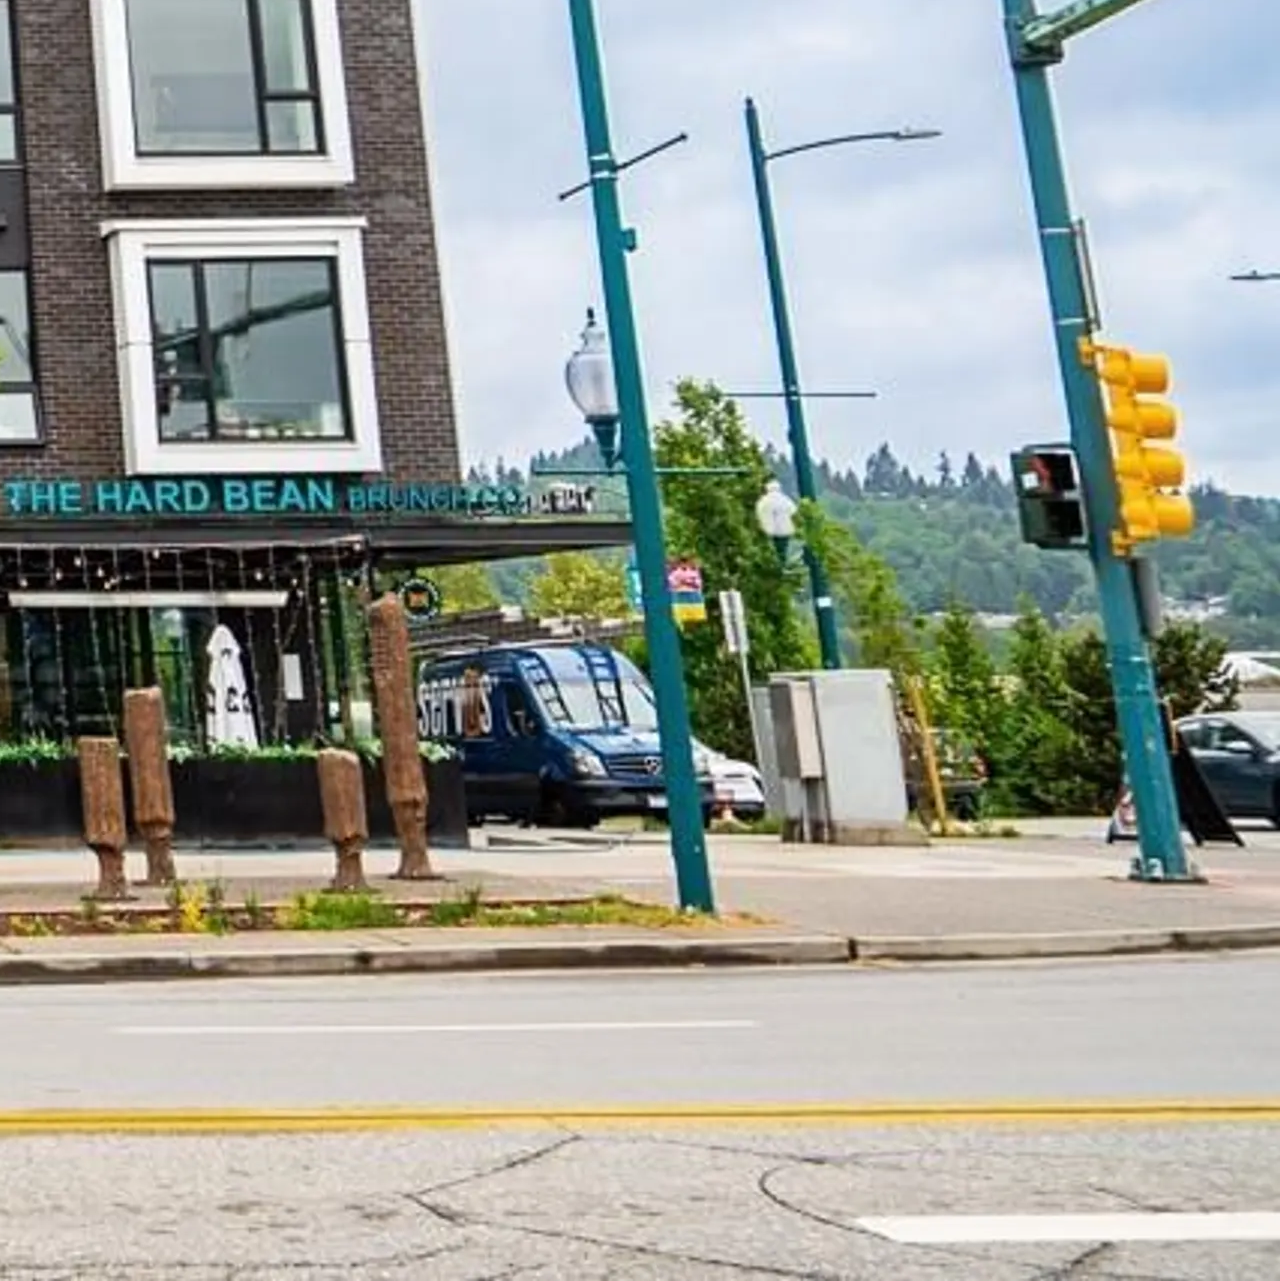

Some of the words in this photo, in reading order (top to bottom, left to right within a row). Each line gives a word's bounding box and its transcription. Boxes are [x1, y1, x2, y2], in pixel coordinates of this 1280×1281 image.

[3, 480, 83, 513] THE
[96, 480, 211, 513] HARD
[222, 479, 335, 512] BEAN
